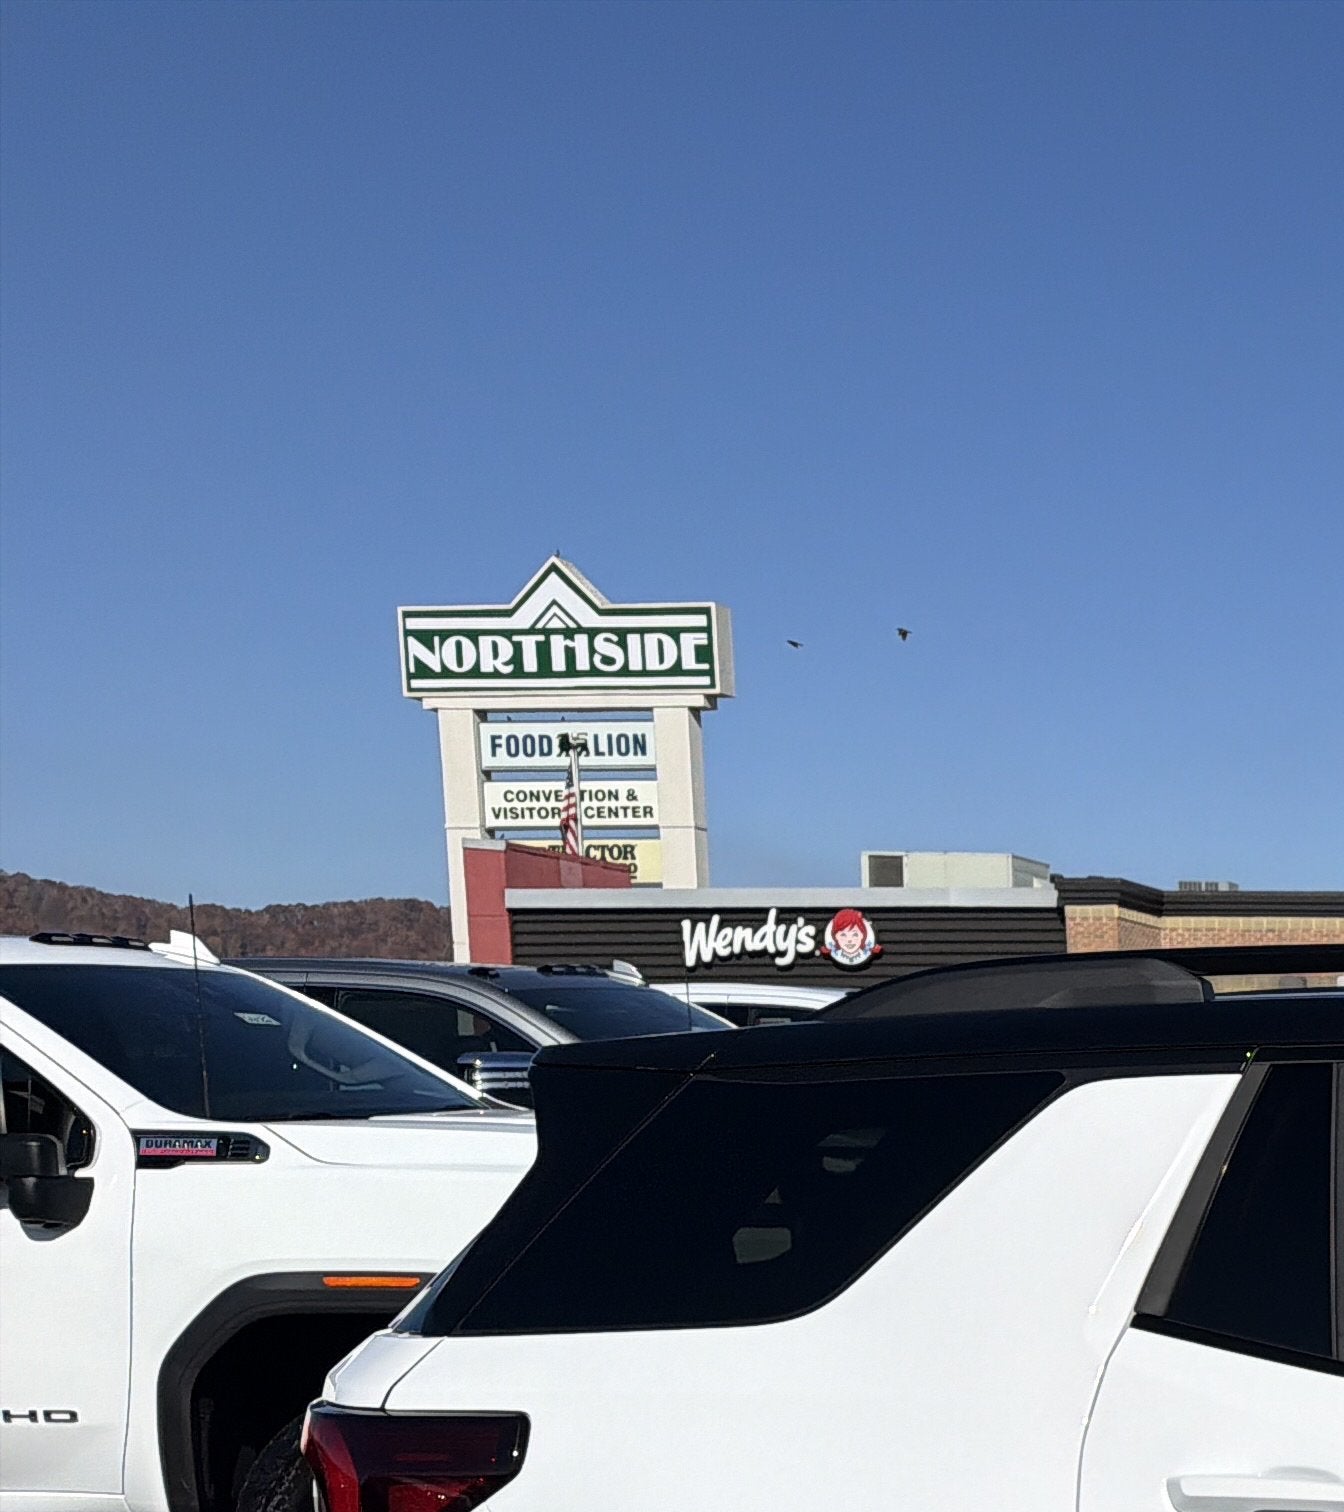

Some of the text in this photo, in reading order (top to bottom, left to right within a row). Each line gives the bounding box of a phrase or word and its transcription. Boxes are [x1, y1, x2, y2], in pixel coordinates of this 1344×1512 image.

[407, 632, 710, 674] NORTHSIDE
[490, 732, 648, 758] FOOD LION
[503, 788, 638, 803] CONVETION &
[491, 805, 654, 820] VISITOR CENTER
[681, 907, 816, 968] Wendy's
[2, 1409, 79, 1423] HD
